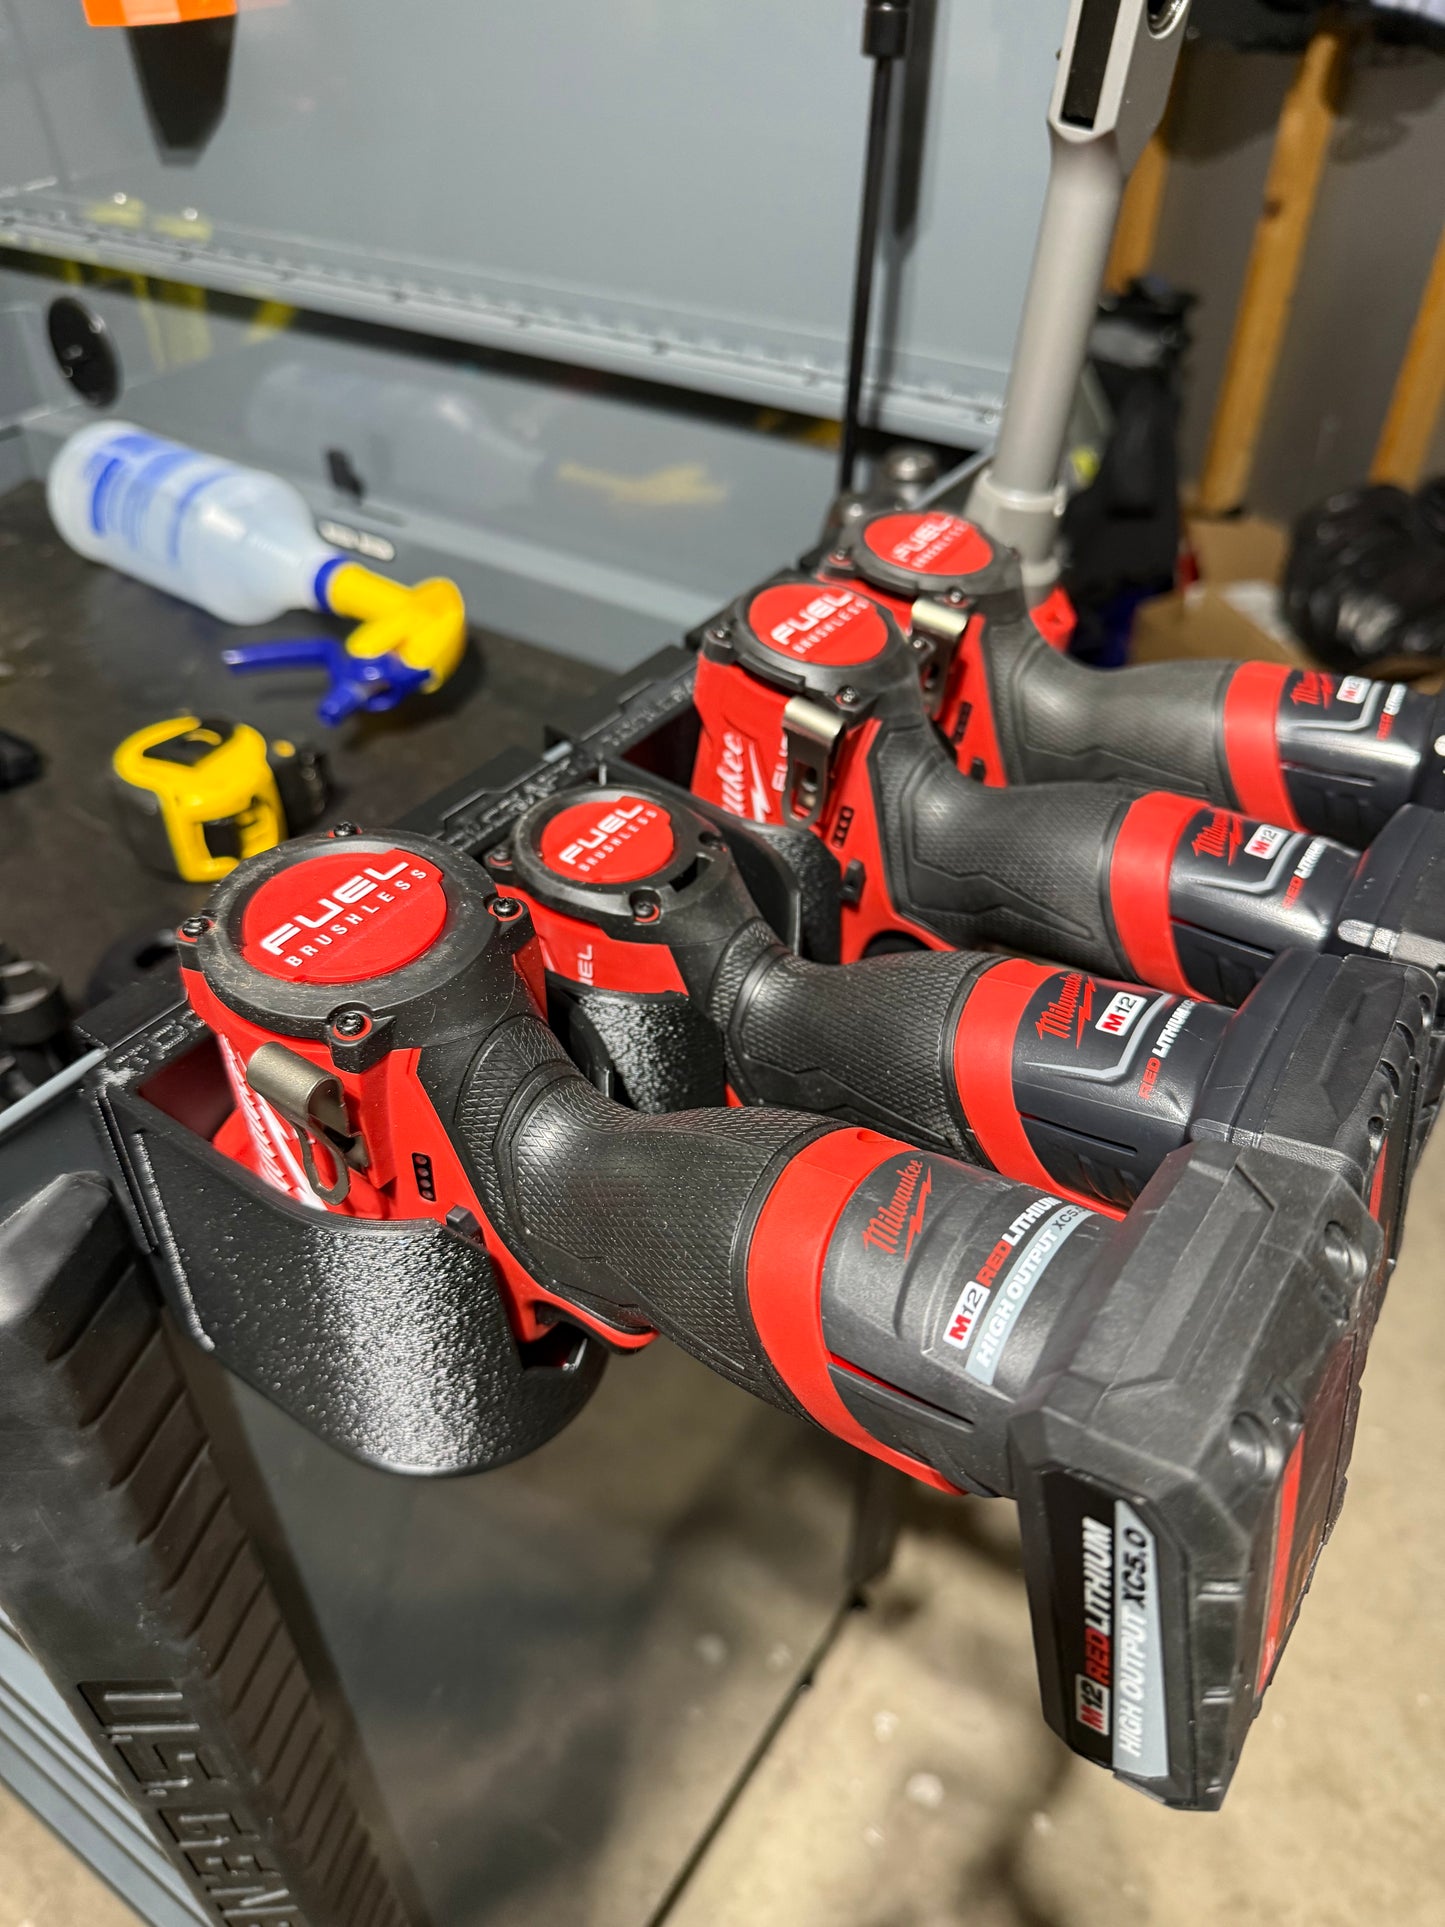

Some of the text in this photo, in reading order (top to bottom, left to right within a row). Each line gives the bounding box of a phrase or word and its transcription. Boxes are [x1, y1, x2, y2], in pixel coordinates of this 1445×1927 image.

[770, 592, 854, 646] FUEL
[558, 804, 644, 865] FUEL
[577, 809, 658, 872] BRUSHLESS
[259, 861, 410, 956] FUEL
[283, 868, 427, 967] BRUSHLESS
[1100, 995, 1138, 1033] M12
[862, 1159, 925, 1256] Milwaukee
[947, 1287, 986, 1343] M12
[976, 1302, 1016, 1369] HIGH
[1006, 1229, 1058, 1300] OUTPUT
[1118, 1526, 1148, 1758] HIGH OUTPUT XC5.0
[1080, 1677, 1105, 1731] M12
